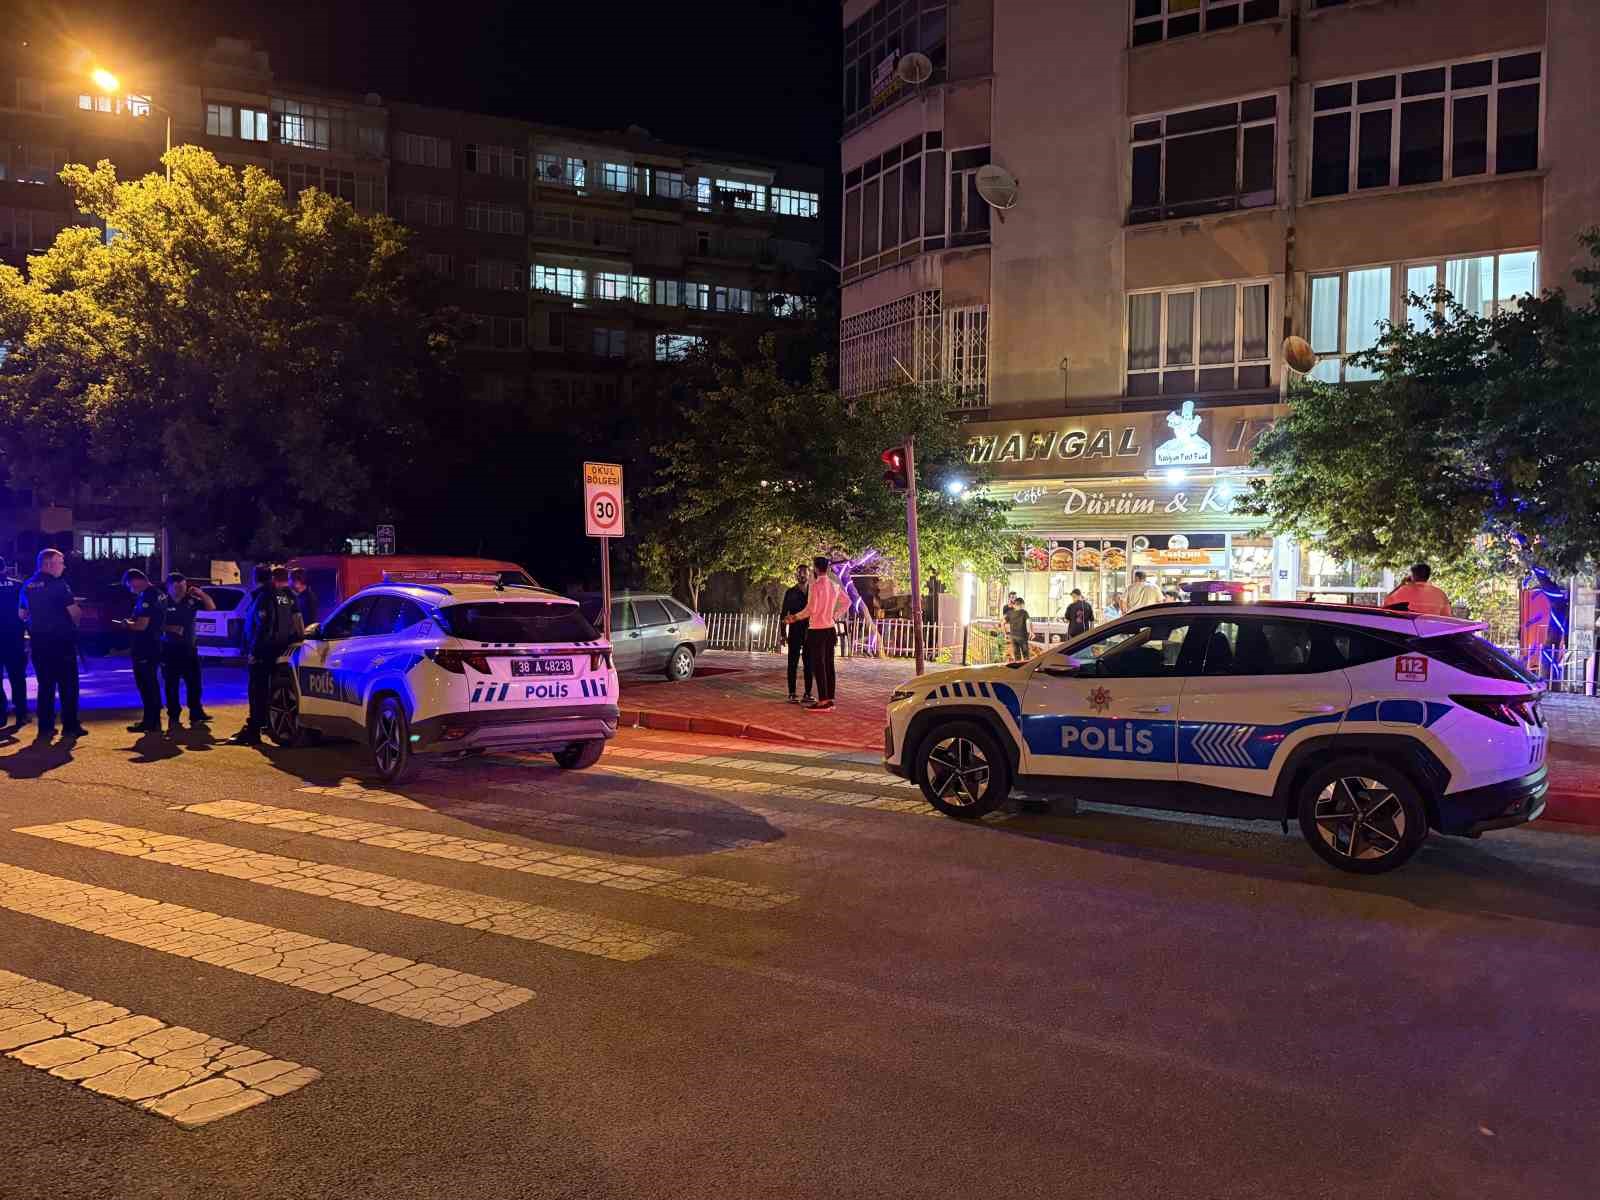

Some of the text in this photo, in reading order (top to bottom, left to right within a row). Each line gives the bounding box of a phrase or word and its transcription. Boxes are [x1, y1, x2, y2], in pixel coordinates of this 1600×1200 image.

[966, 427, 1141, 464] MANGAL
[591, 465, 615, 476] OKUL
[1057, 487, 1155, 515] Dürüm
[1164, 492, 1188, 513] &
[596, 502, 614, 518] 30
[518, 659, 571, 673] 38 A 48238
[1400, 658, 1424, 672] 112
[309, 671, 335, 695] POLİS
[525, 682, 569, 698] POLİS
[1061, 721, 1154, 754] POLİS
